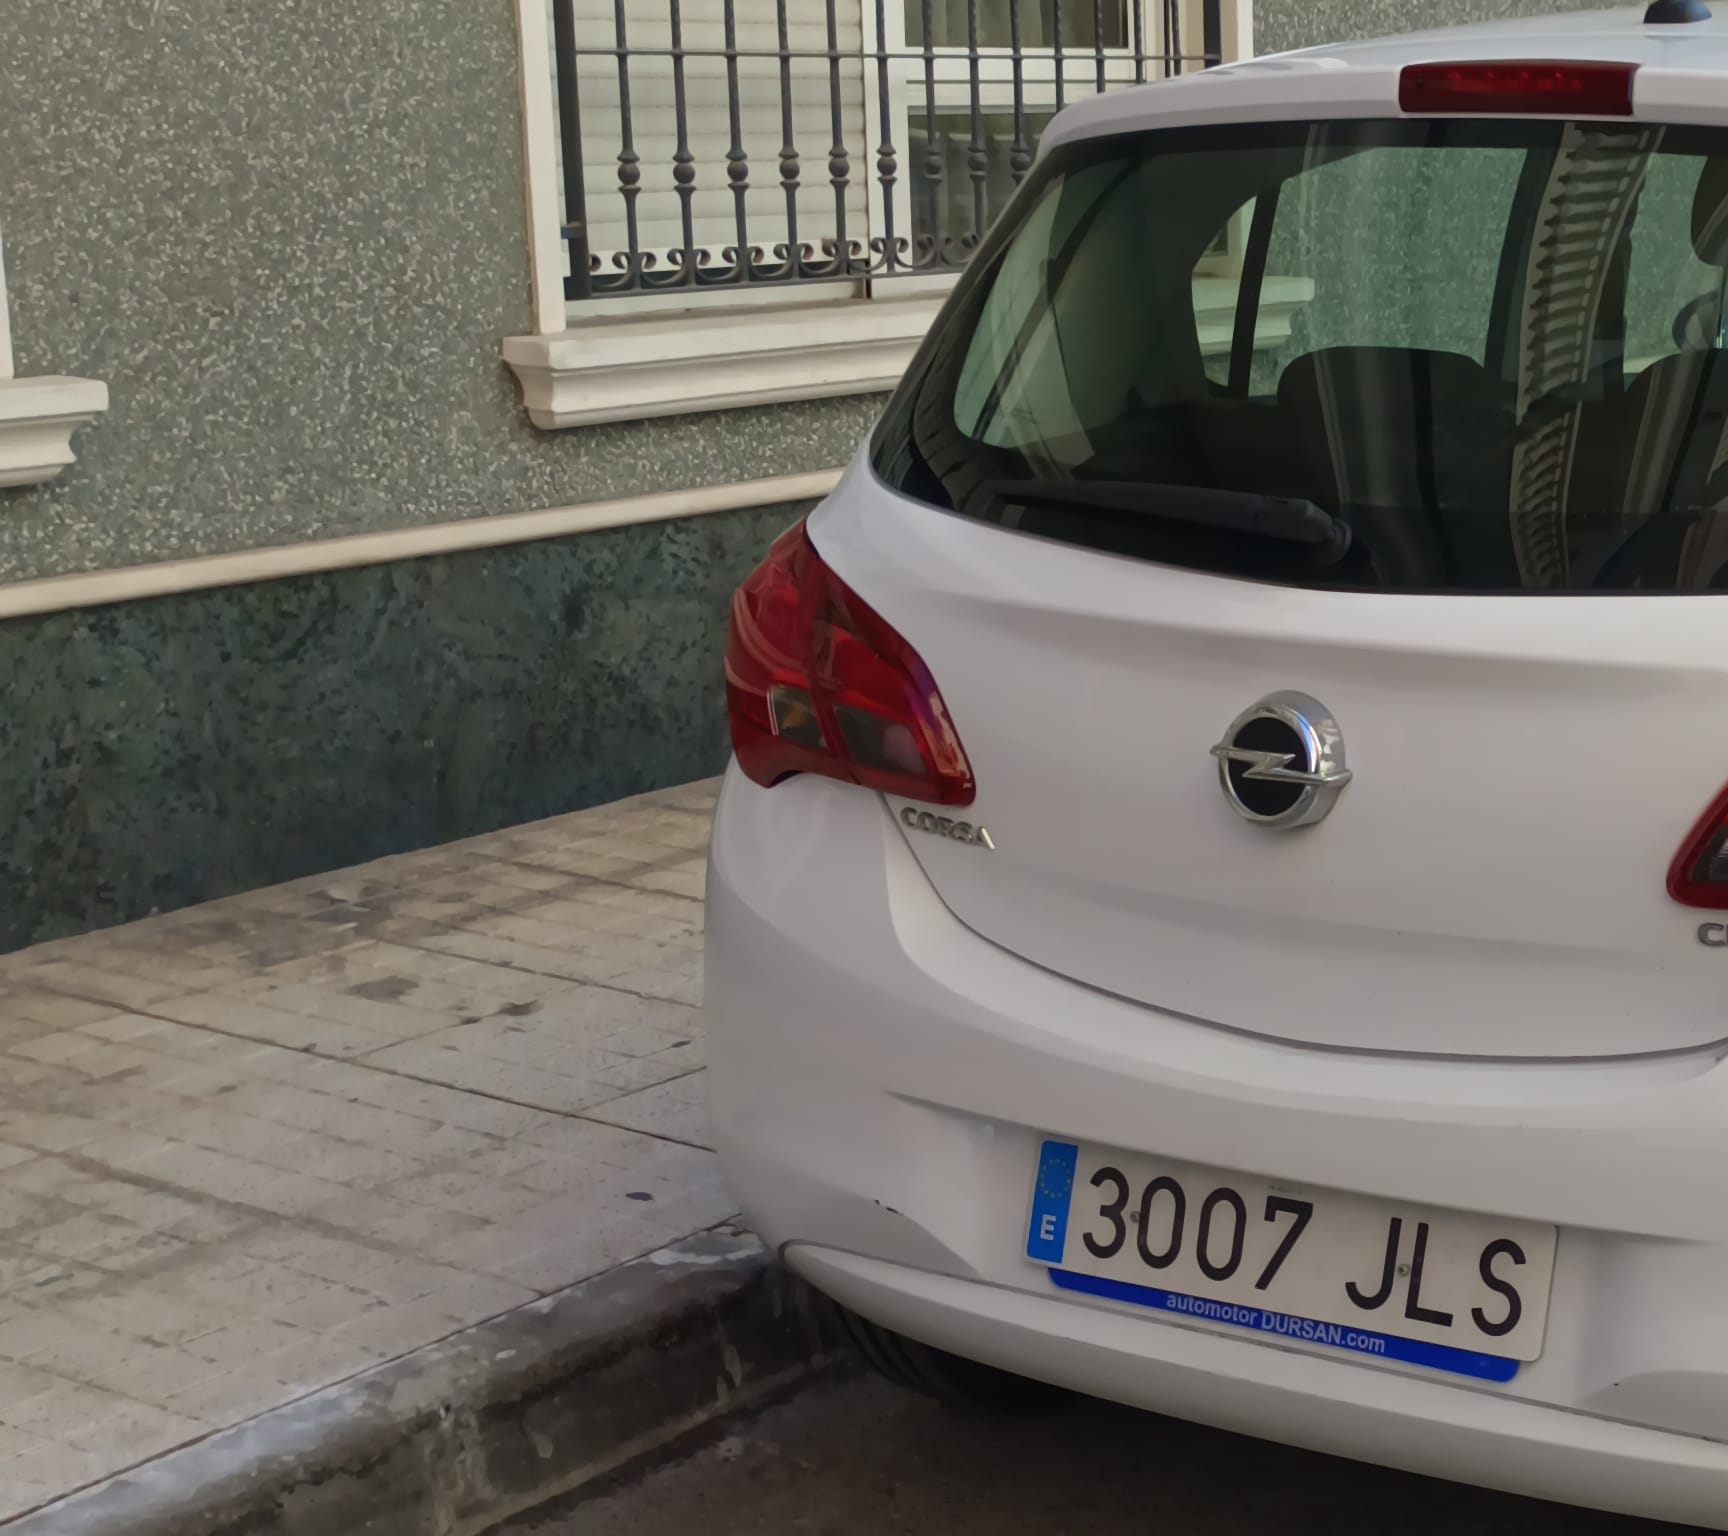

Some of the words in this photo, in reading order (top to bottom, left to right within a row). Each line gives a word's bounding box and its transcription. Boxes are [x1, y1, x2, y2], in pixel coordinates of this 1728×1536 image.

[901, 806, 996, 850] CORSA
[1040, 1214, 1056, 1241] E
[1082, 1166, 1314, 1290] 3007
[1345, 1216, 1527, 1336] JLS
[1166, 1294, 1258, 1324] automotor
[1261, 1311, 1385, 1353] DURSAN.com
